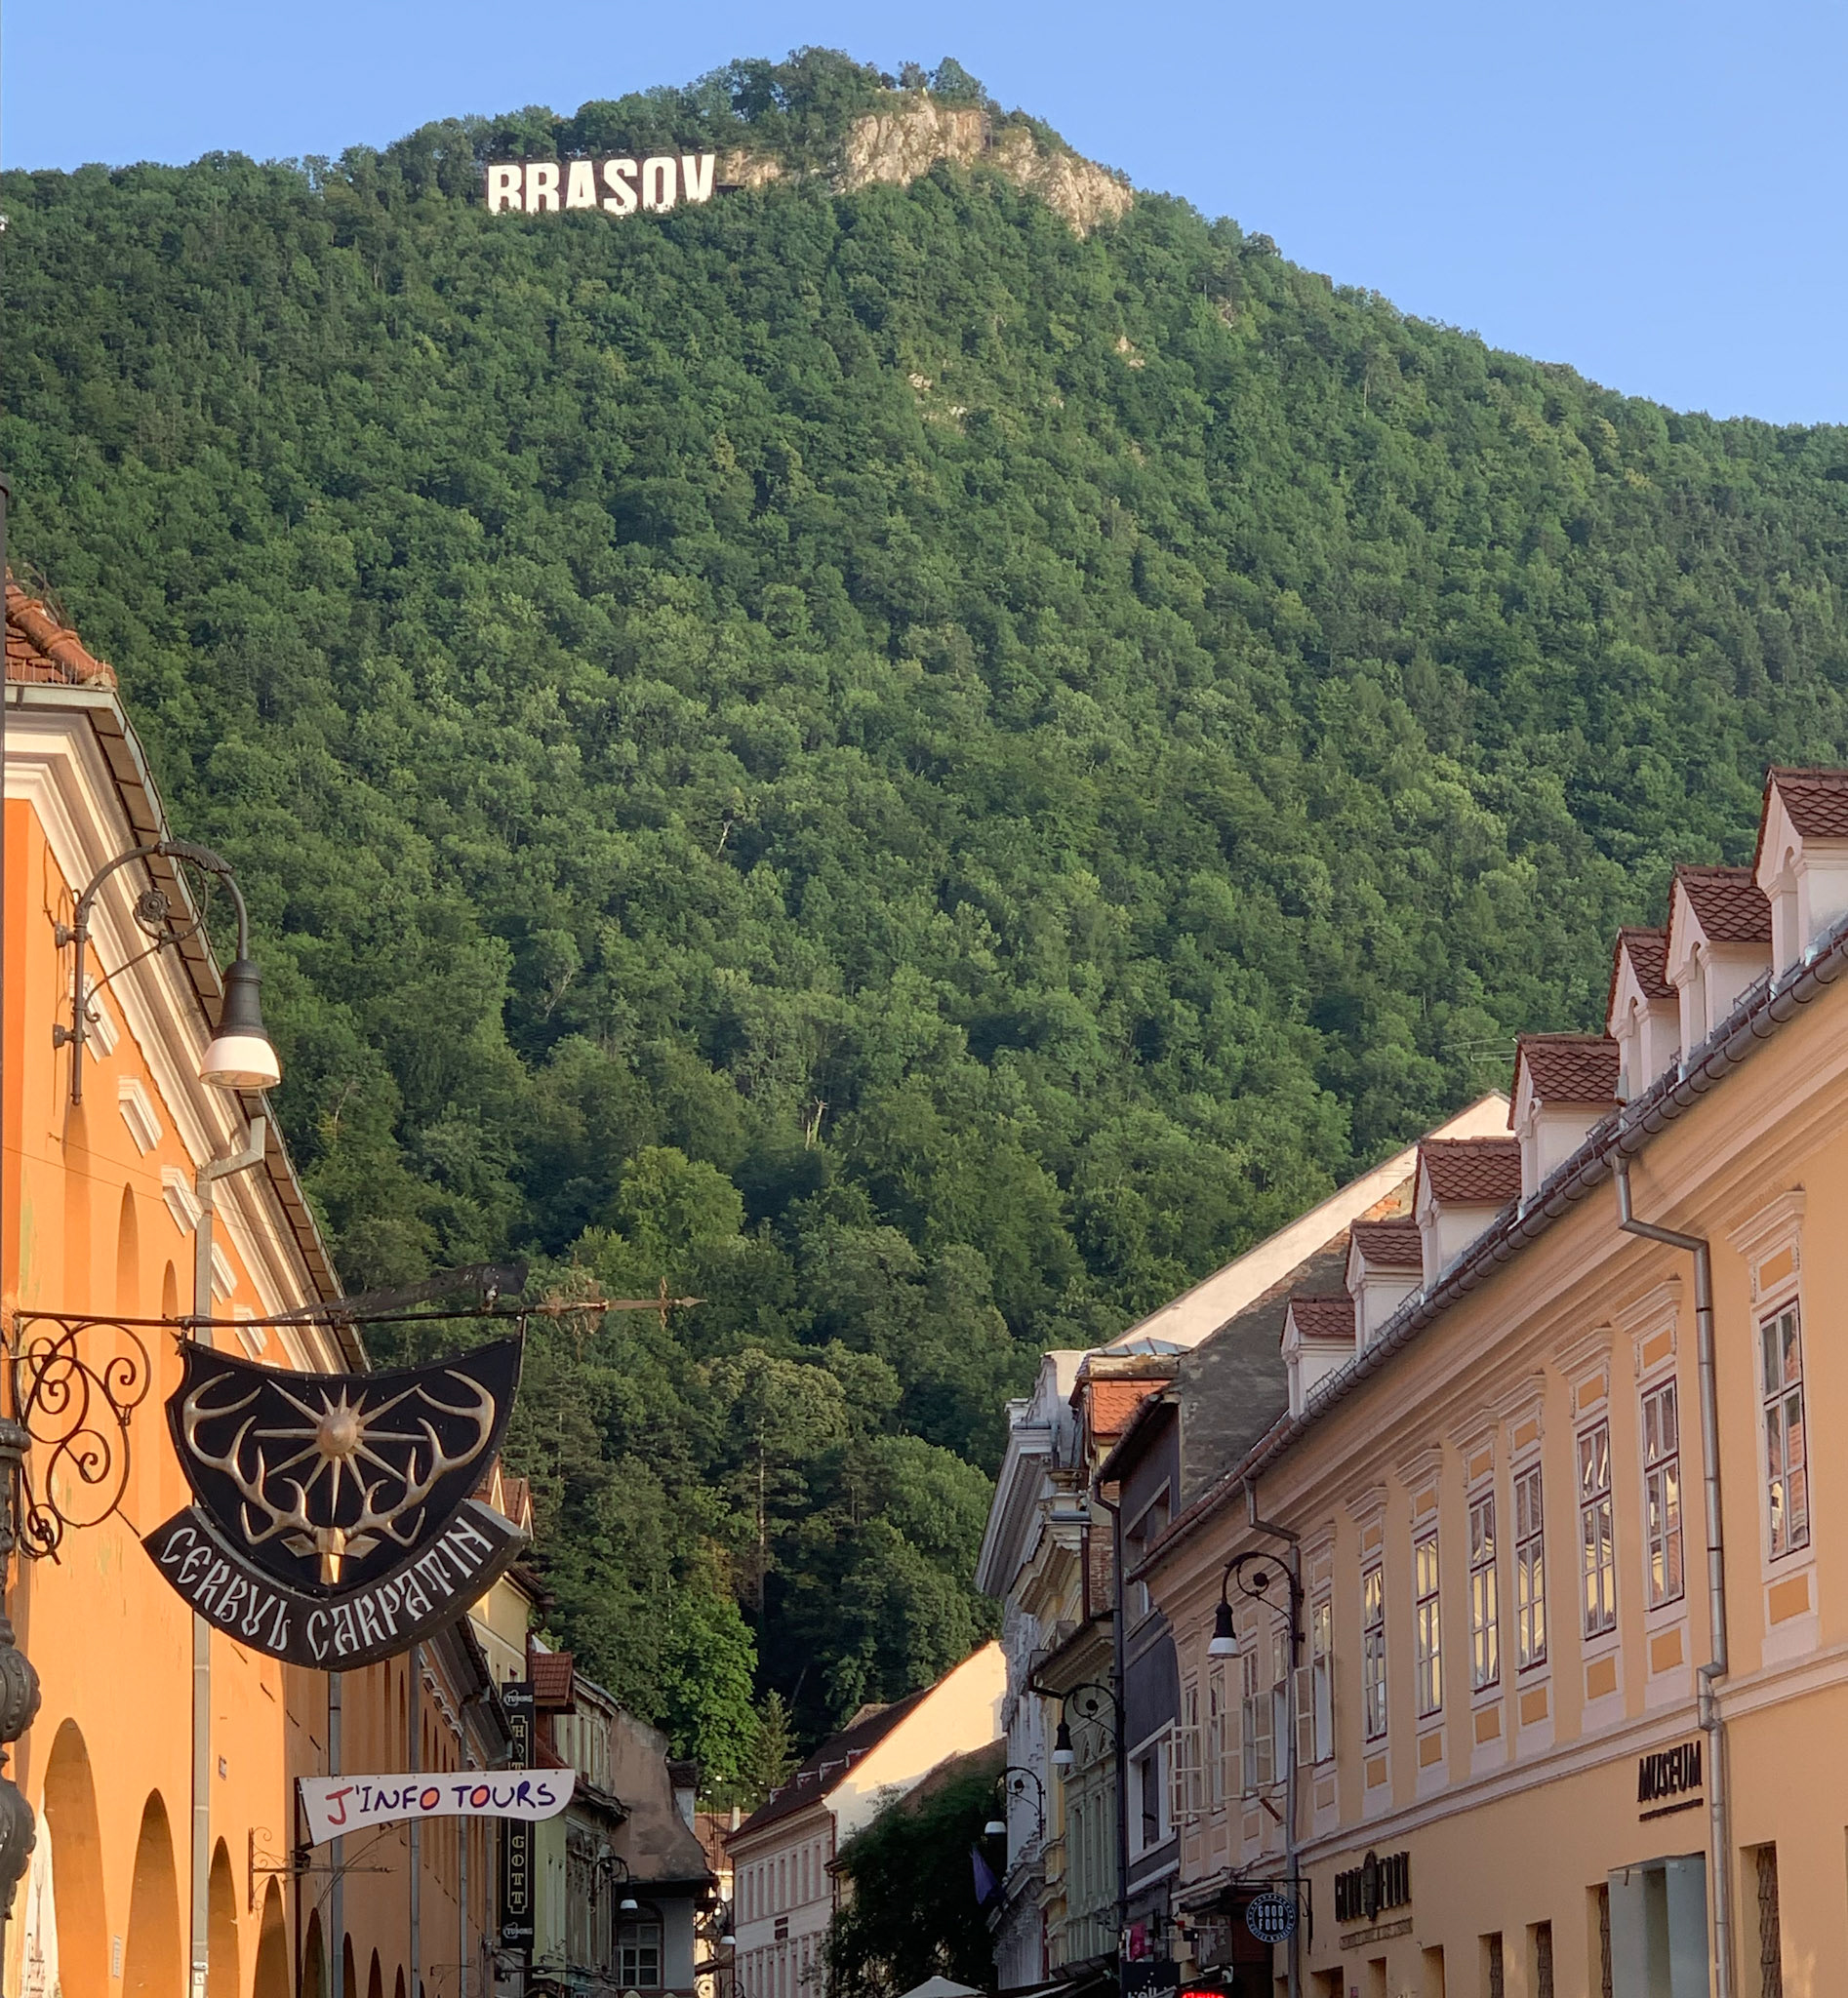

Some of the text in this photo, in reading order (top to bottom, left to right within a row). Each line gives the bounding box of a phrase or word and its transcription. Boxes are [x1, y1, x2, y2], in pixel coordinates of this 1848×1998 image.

[488, 154, 715, 218] BRASOV
[159, 1516, 494, 1661] CERBUL CARPATIN
[1637, 1740, 1703, 1804] MUSEUM
[325, 1780, 556, 1825] J'INFO TOURS
[1258, 1904, 1284, 1918] GOOD
[1259, 1918, 1284, 1931] FOOD
